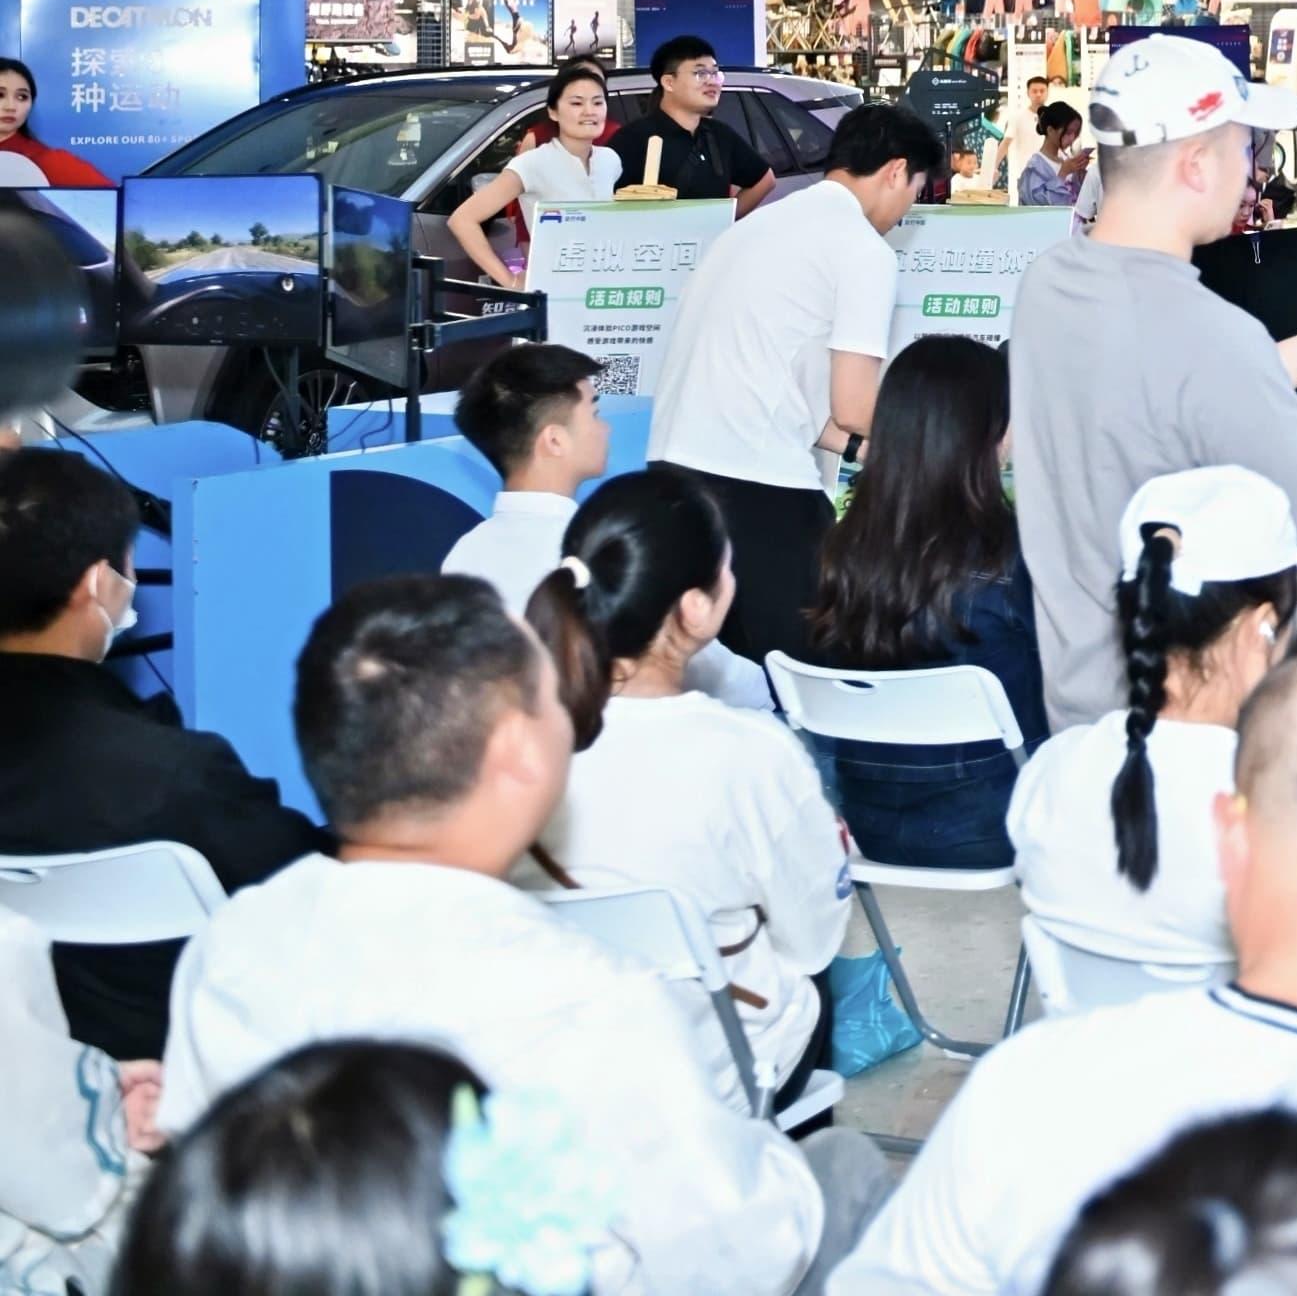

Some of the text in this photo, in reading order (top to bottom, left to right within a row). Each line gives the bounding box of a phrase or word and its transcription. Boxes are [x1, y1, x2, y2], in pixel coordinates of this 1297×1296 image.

[70, 6, 213, 29] DECATLON
[71, 82, 181, 113] 种运动
[70, 135, 119, 145] EXPLORE
[125, 135, 146, 144] OUR
[551, 240, 700, 273] 虚拟空间
[589, 289, 663, 307] 活动规则
[926, 297, 998, 315] 活动规则
